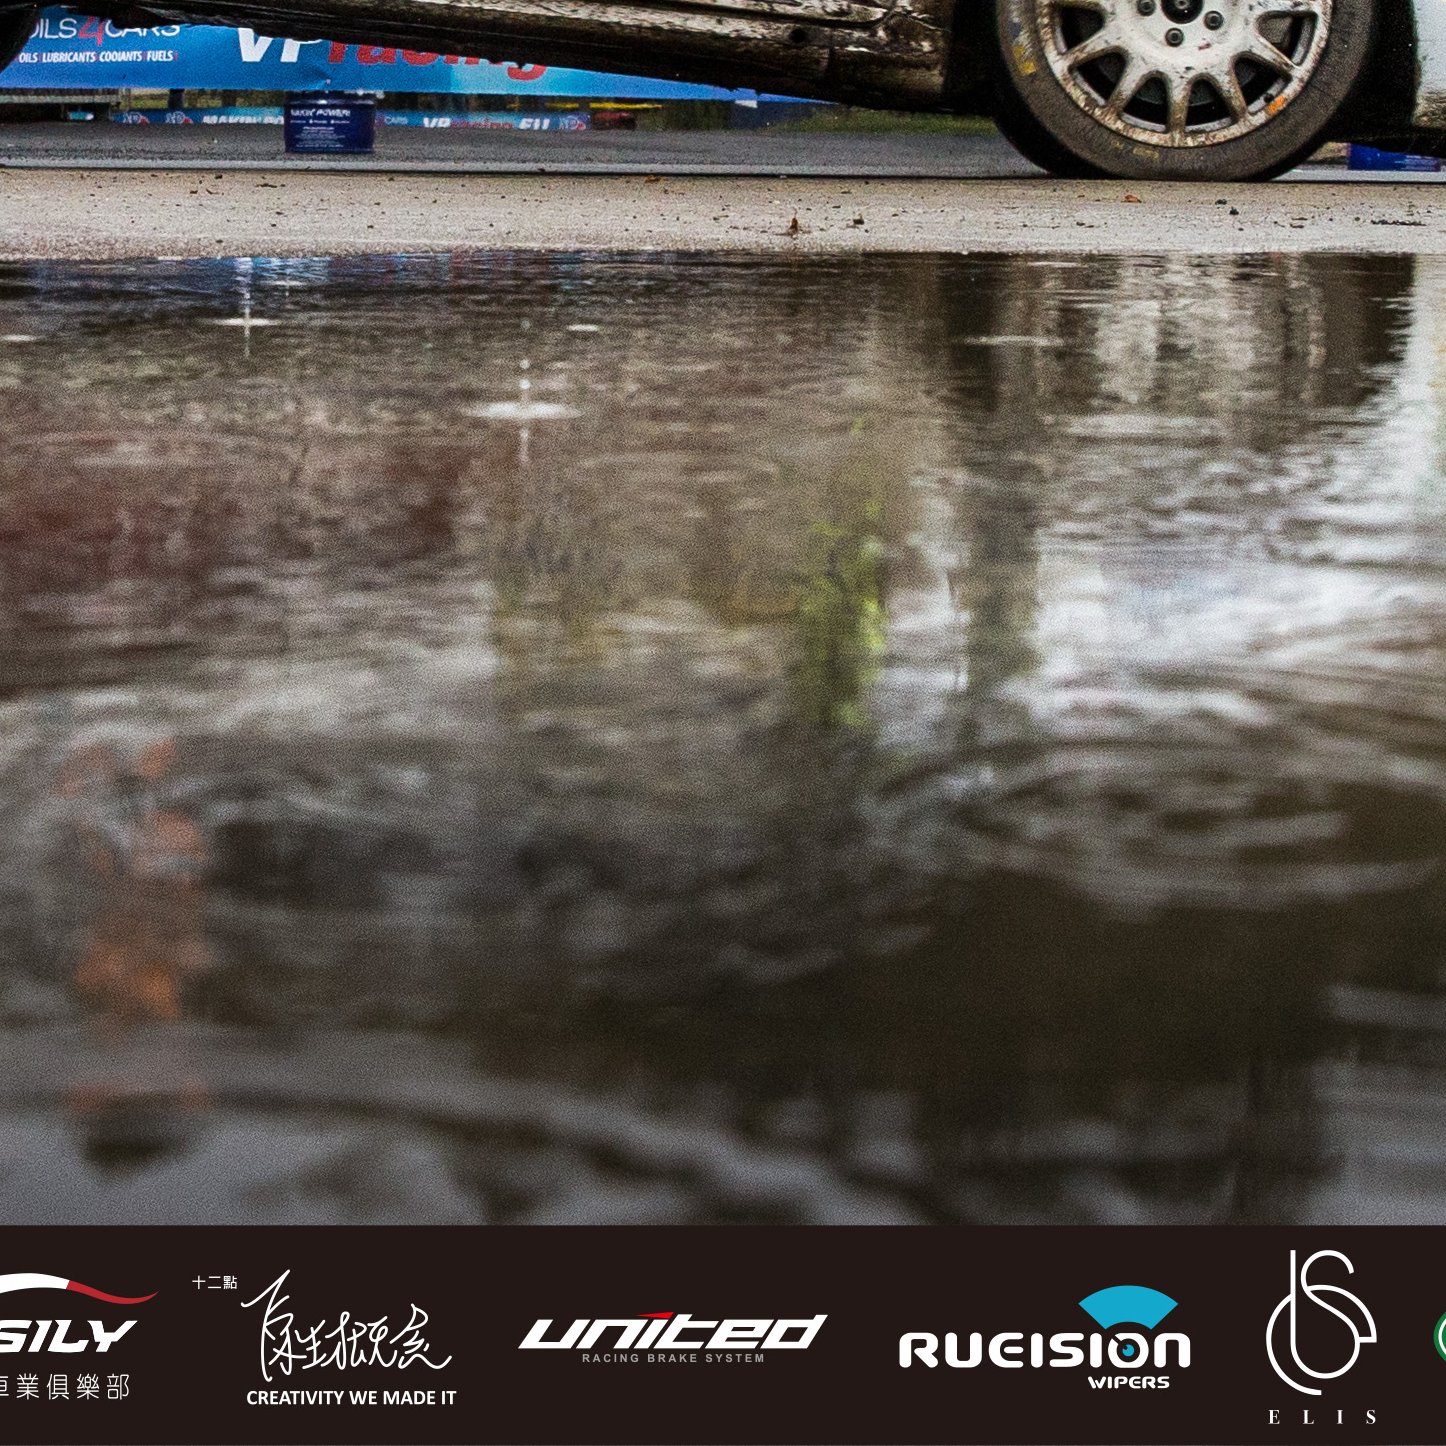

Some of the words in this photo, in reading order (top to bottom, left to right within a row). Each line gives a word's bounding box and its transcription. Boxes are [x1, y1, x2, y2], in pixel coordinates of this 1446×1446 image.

[19, 53, 38, 63] OILS
[42, 51, 96, 63] LUBRICANTS
[146, 50, 174, 62] FUELS
